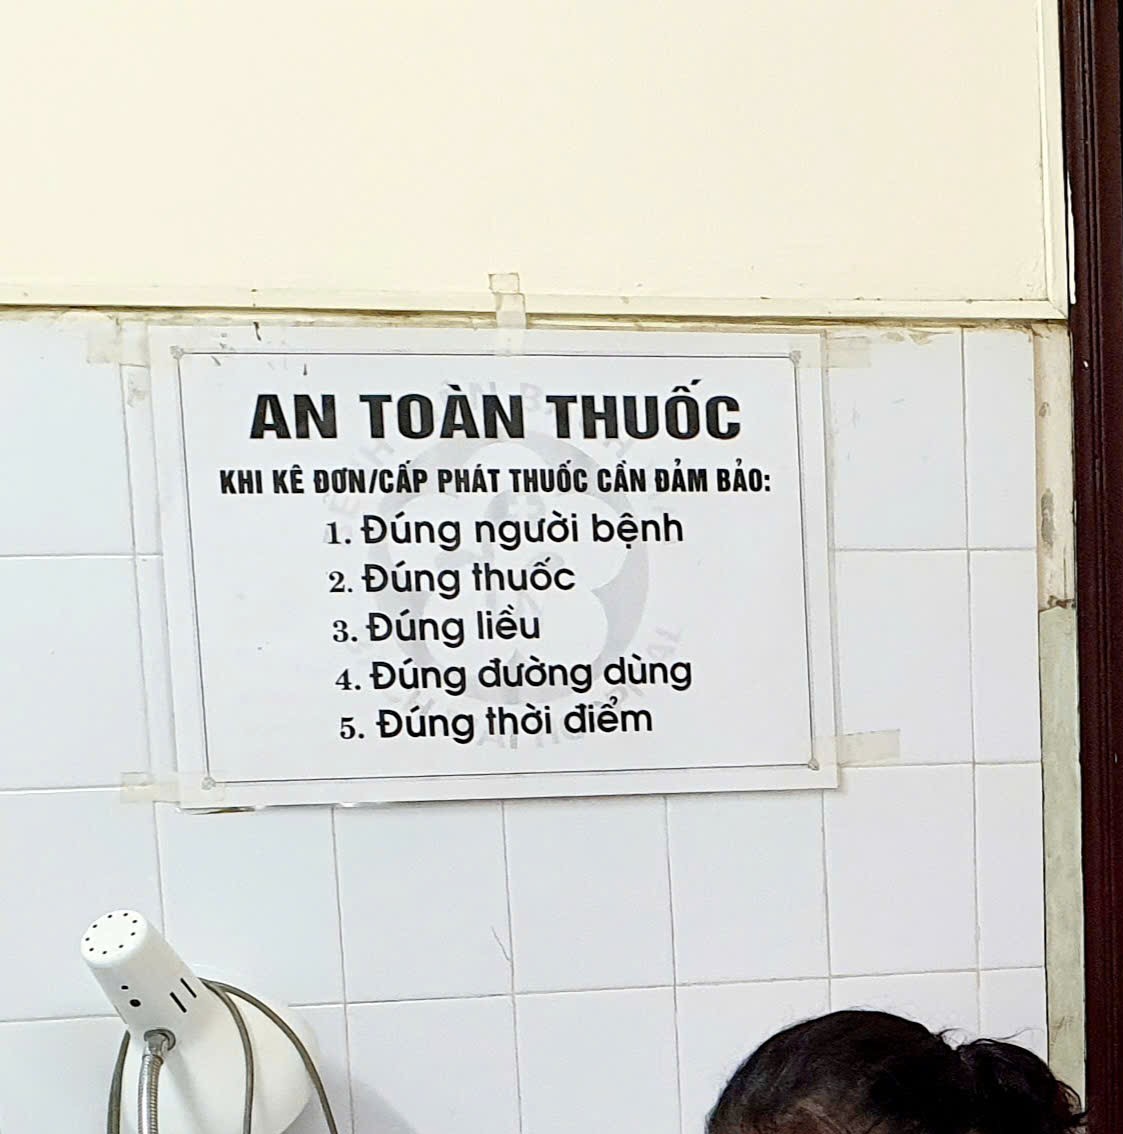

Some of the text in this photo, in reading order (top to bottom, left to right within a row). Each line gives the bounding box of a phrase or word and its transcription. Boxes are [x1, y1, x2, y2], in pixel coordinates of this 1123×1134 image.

[249, 378, 741, 440] AN TOÀN THUỐC
[219, 469, 263, 494] KHI
[272, 464, 305, 494] KÊ
[437, 463, 501, 493] PHÁT
[508, 459, 588, 493] THUỐC
[597, 459, 647, 493] CẦN
[654, 458, 708, 493] ĐẢM
[716, 458, 771, 492] BẢO:
[326, 510, 684, 552] 1. Đúng người bệnh
[329, 556, 575, 600] 2. Đúng thuốc
[332, 604, 540, 649] 3. Đúng liều
[335, 653, 692, 697] 4. Đúng đường dùng
[340, 695, 653, 745] 5. Đúng thời điểm
